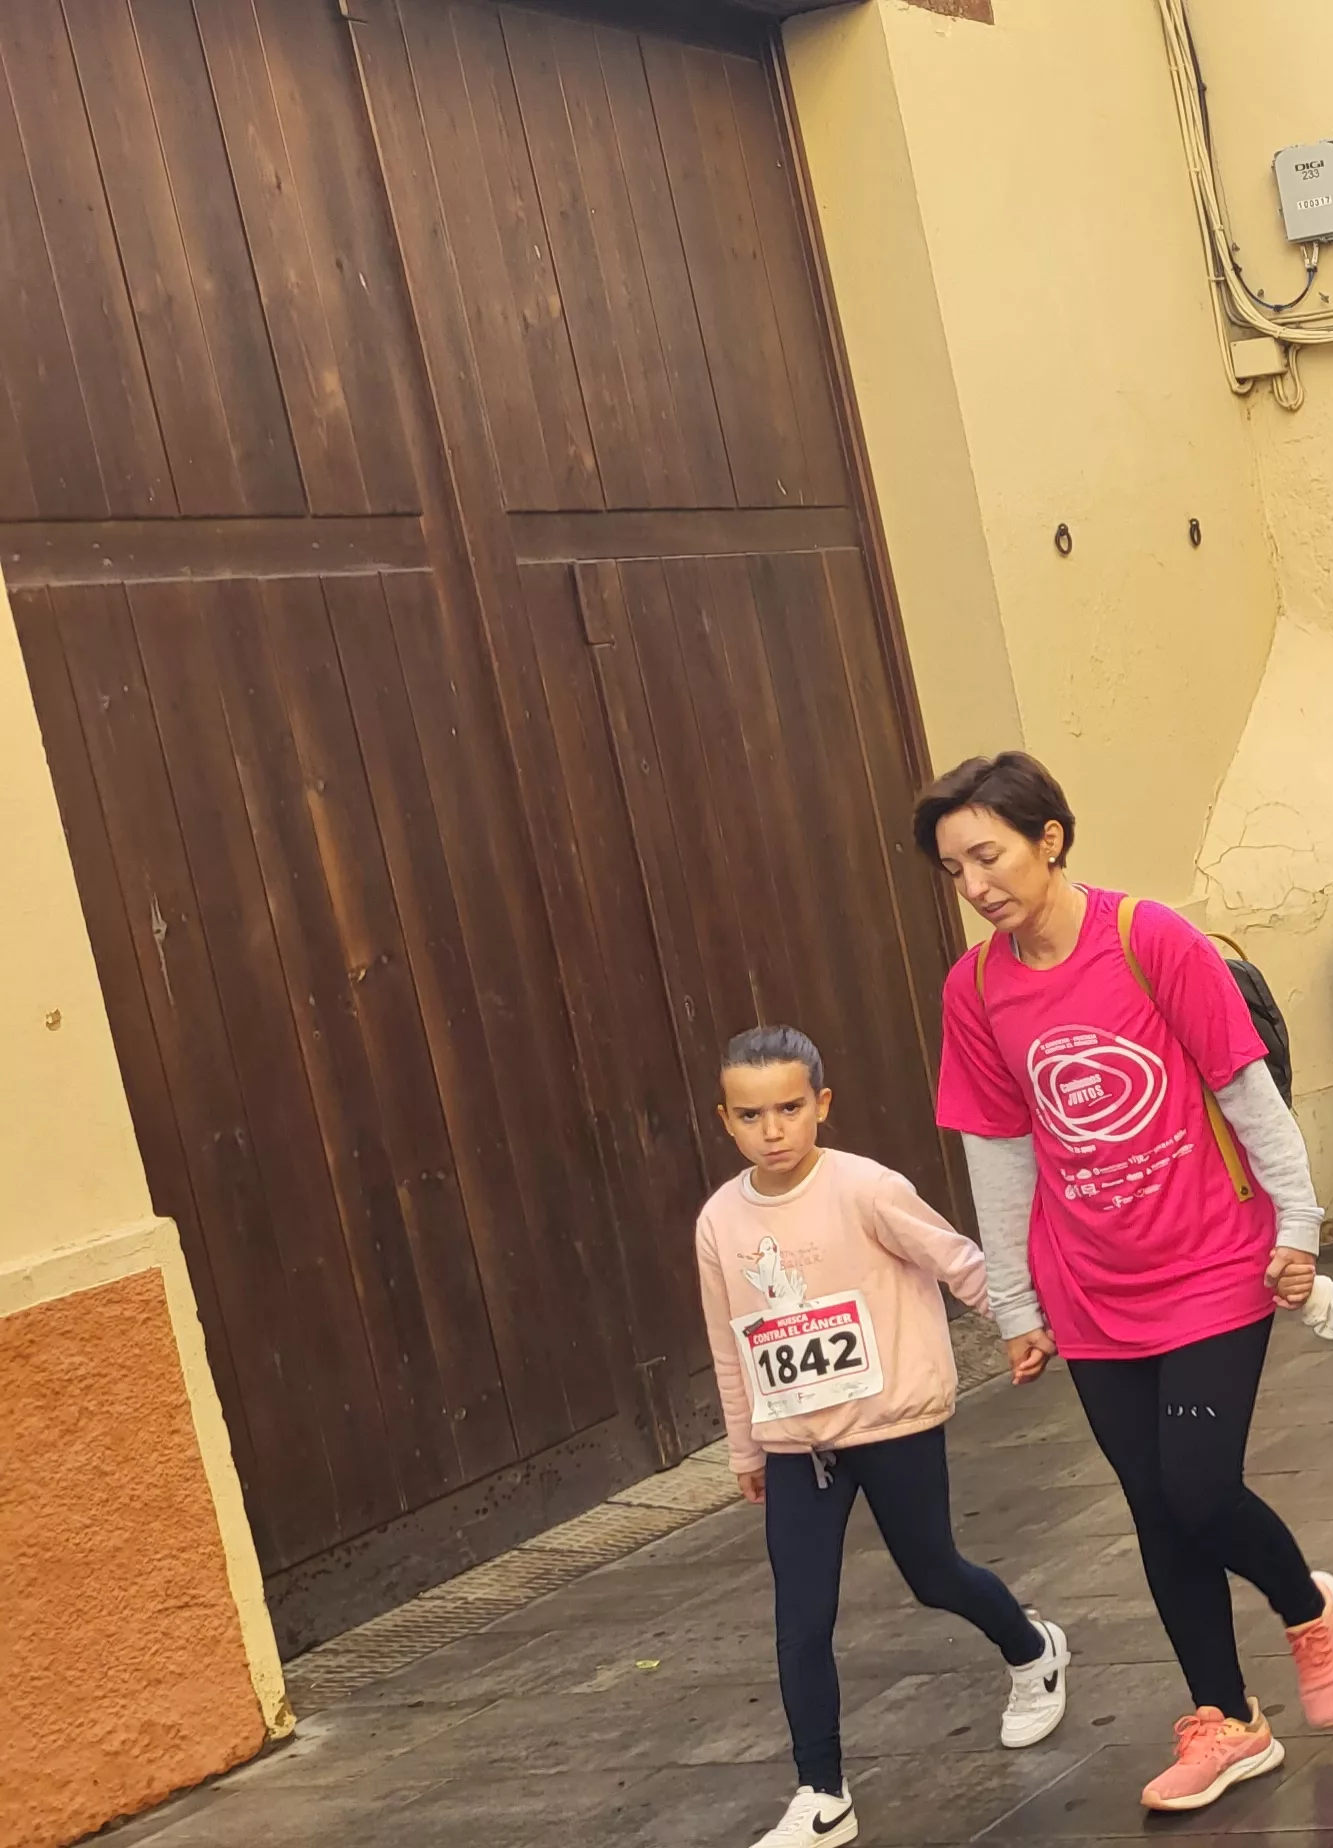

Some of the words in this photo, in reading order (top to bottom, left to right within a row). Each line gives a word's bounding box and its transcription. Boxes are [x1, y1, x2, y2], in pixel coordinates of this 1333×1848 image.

[1294, 160, 1325, 172] DIGI
[1301, 168, 1320, 181] 233
[1298, 196, 1330, 209] 100317
[777, 1312, 809, 1328] HUESCA
[753, 1329, 787, 1345] CONTRA
[788, 1325, 801, 1337] EL
[802, 1311, 853, 1334] CÁNCER
[758, 1330, 862, 1387] 1842
